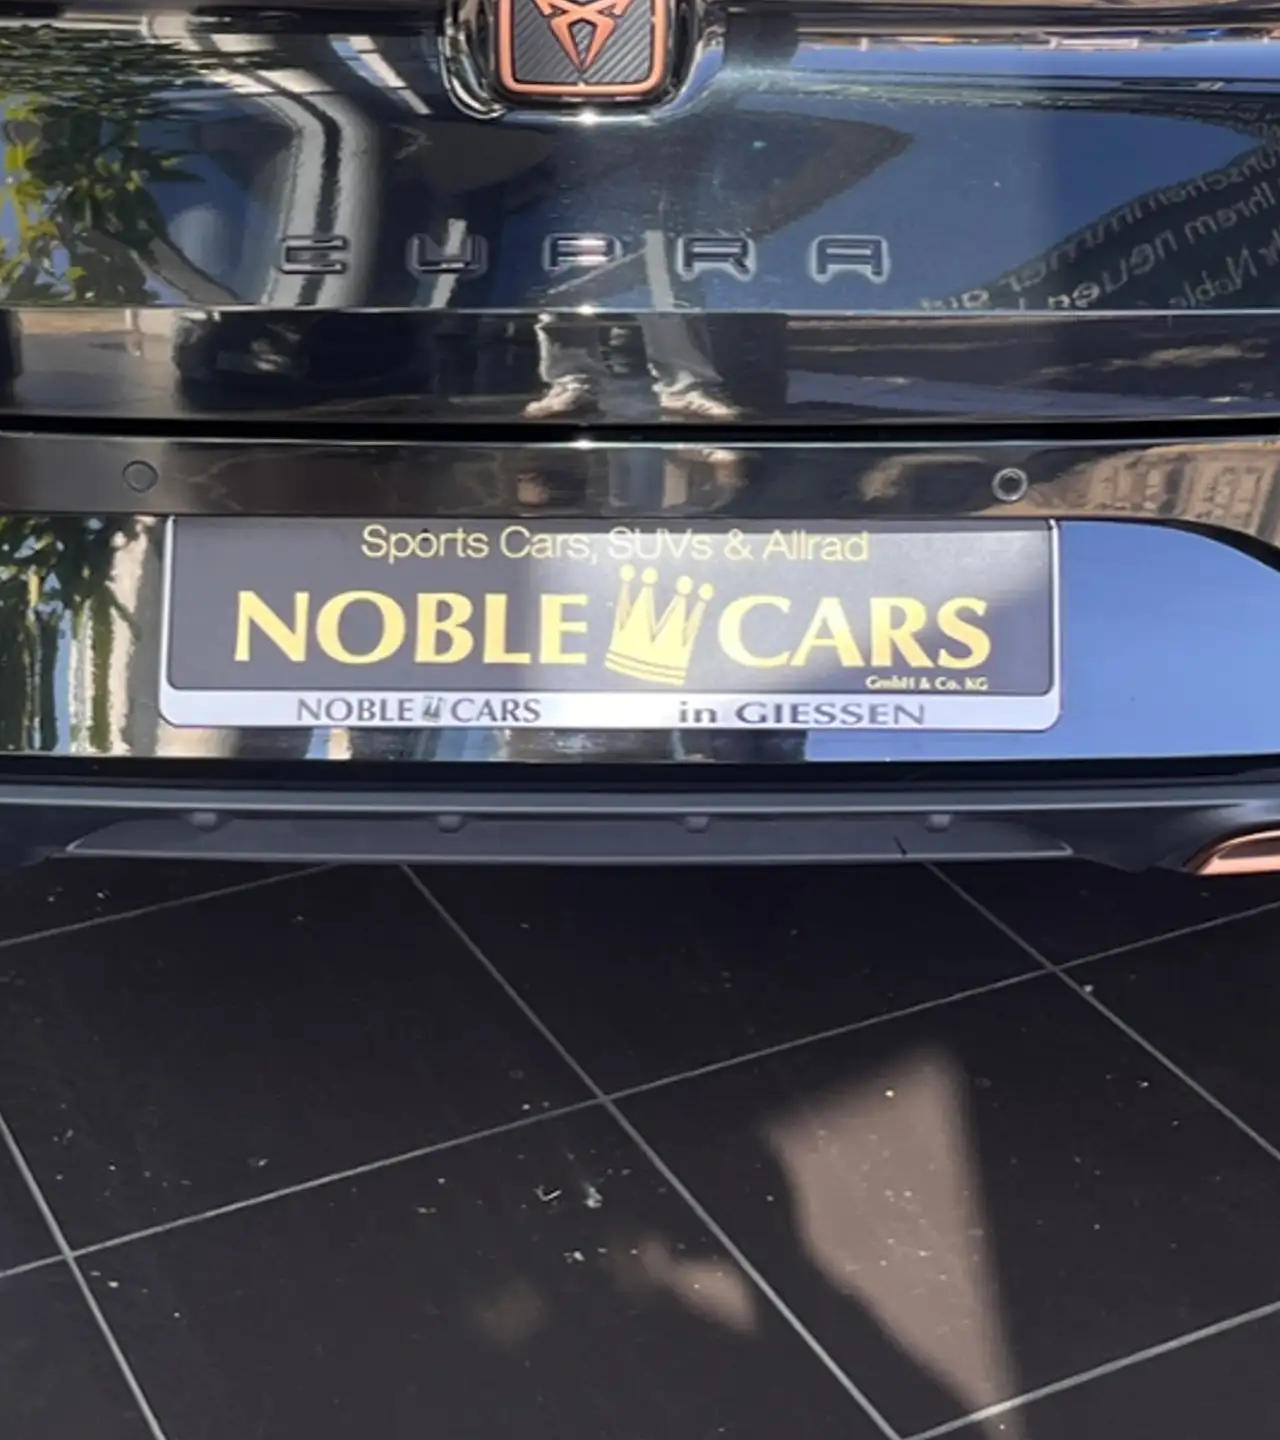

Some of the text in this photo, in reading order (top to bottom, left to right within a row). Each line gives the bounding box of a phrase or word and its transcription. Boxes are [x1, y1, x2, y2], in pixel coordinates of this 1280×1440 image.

[278, 232, 891, 284] CUPRA
[360, 524, 870, 565] Sports Cars, SUVs & Allrad
[233, 590, 993, 670] NOBLE CARS
[864, 674, 989, 691] GmbH & Co. KG
[296, 697, 926, 726] NOBLE CARS in GIESSEN
